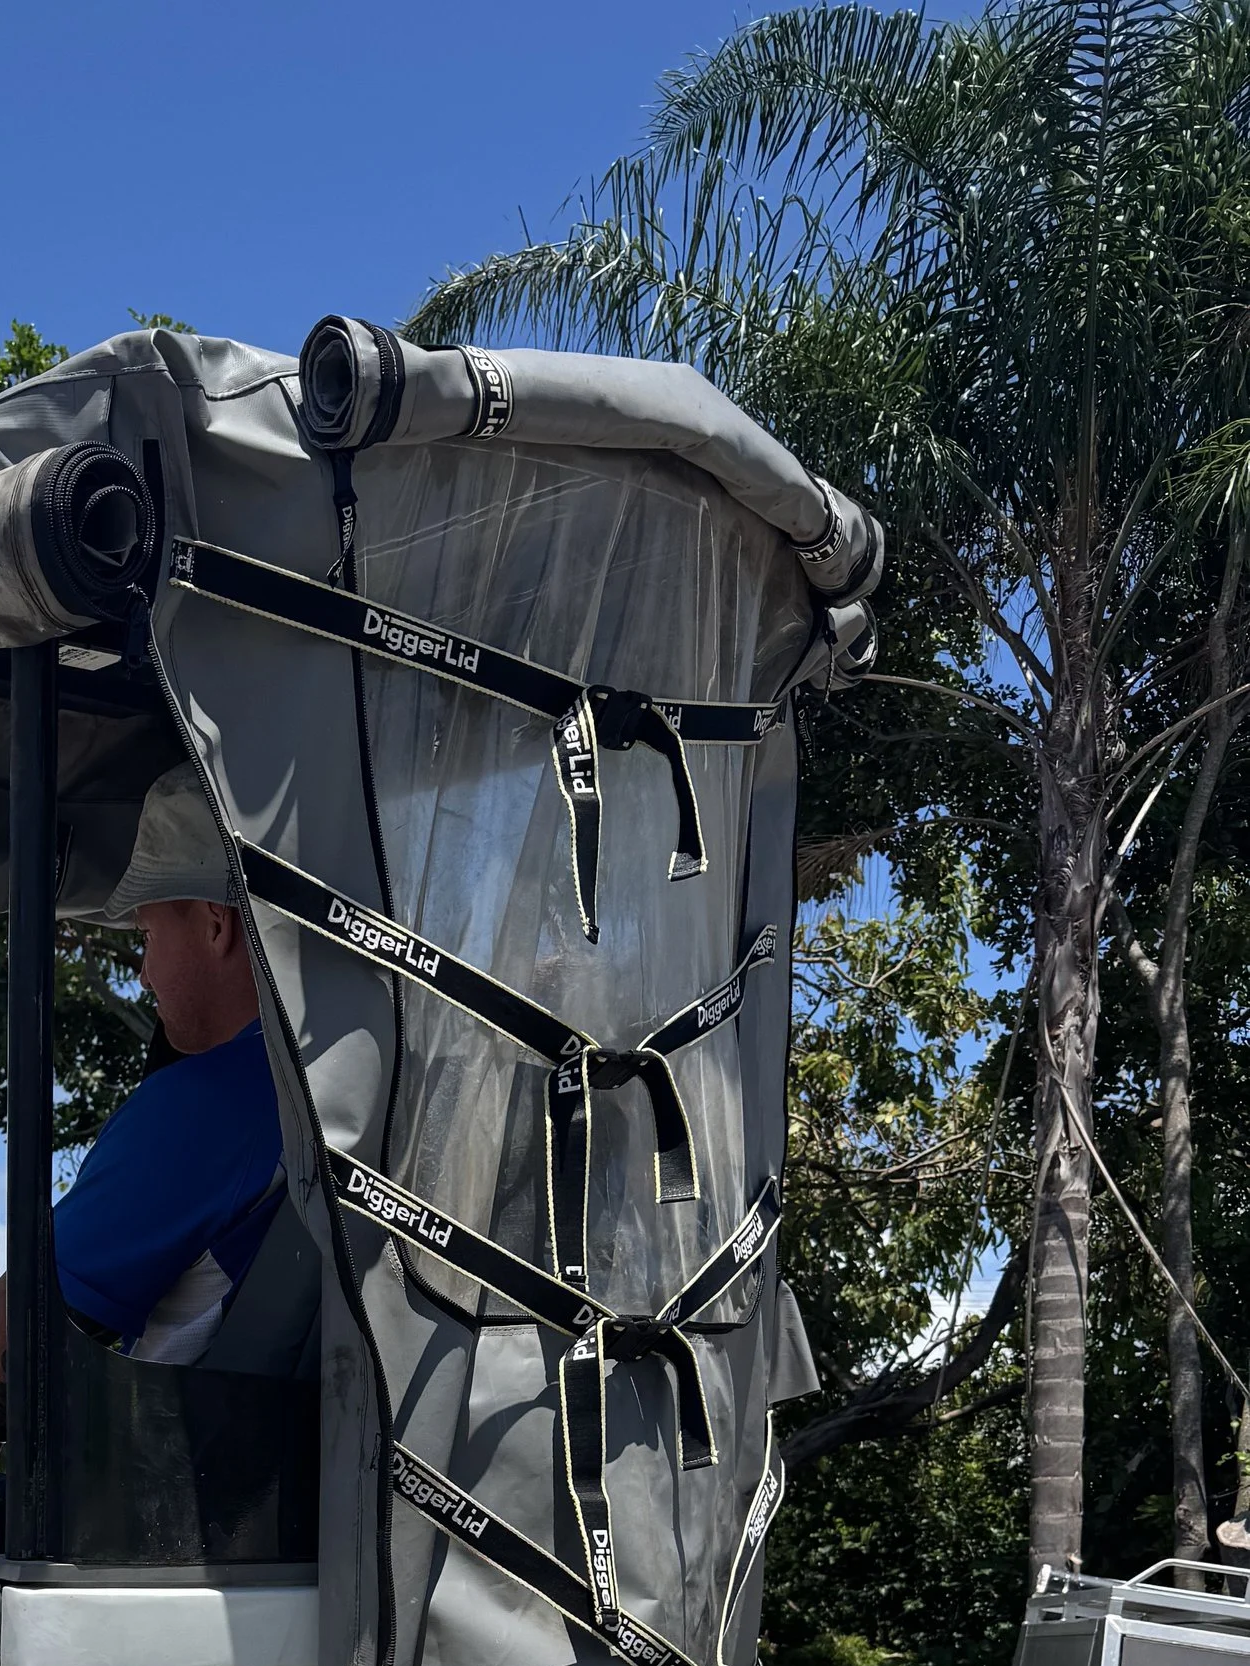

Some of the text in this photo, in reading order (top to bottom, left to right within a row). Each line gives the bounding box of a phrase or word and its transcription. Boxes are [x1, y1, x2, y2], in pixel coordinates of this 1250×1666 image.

[362, 607, 481, 674] DiggerLid
[326, 897, 441, 978] DiggerLid
[697, 976, 741, 1028] DiggerLid
[346, 1168, 454, 1248] DiggerLid
[731, 1211, 765, 1264] DiggerLid
[392, 1450, 490, 1539] DiggerLid
[747, 1469, 779, 1547] DiggerLid
